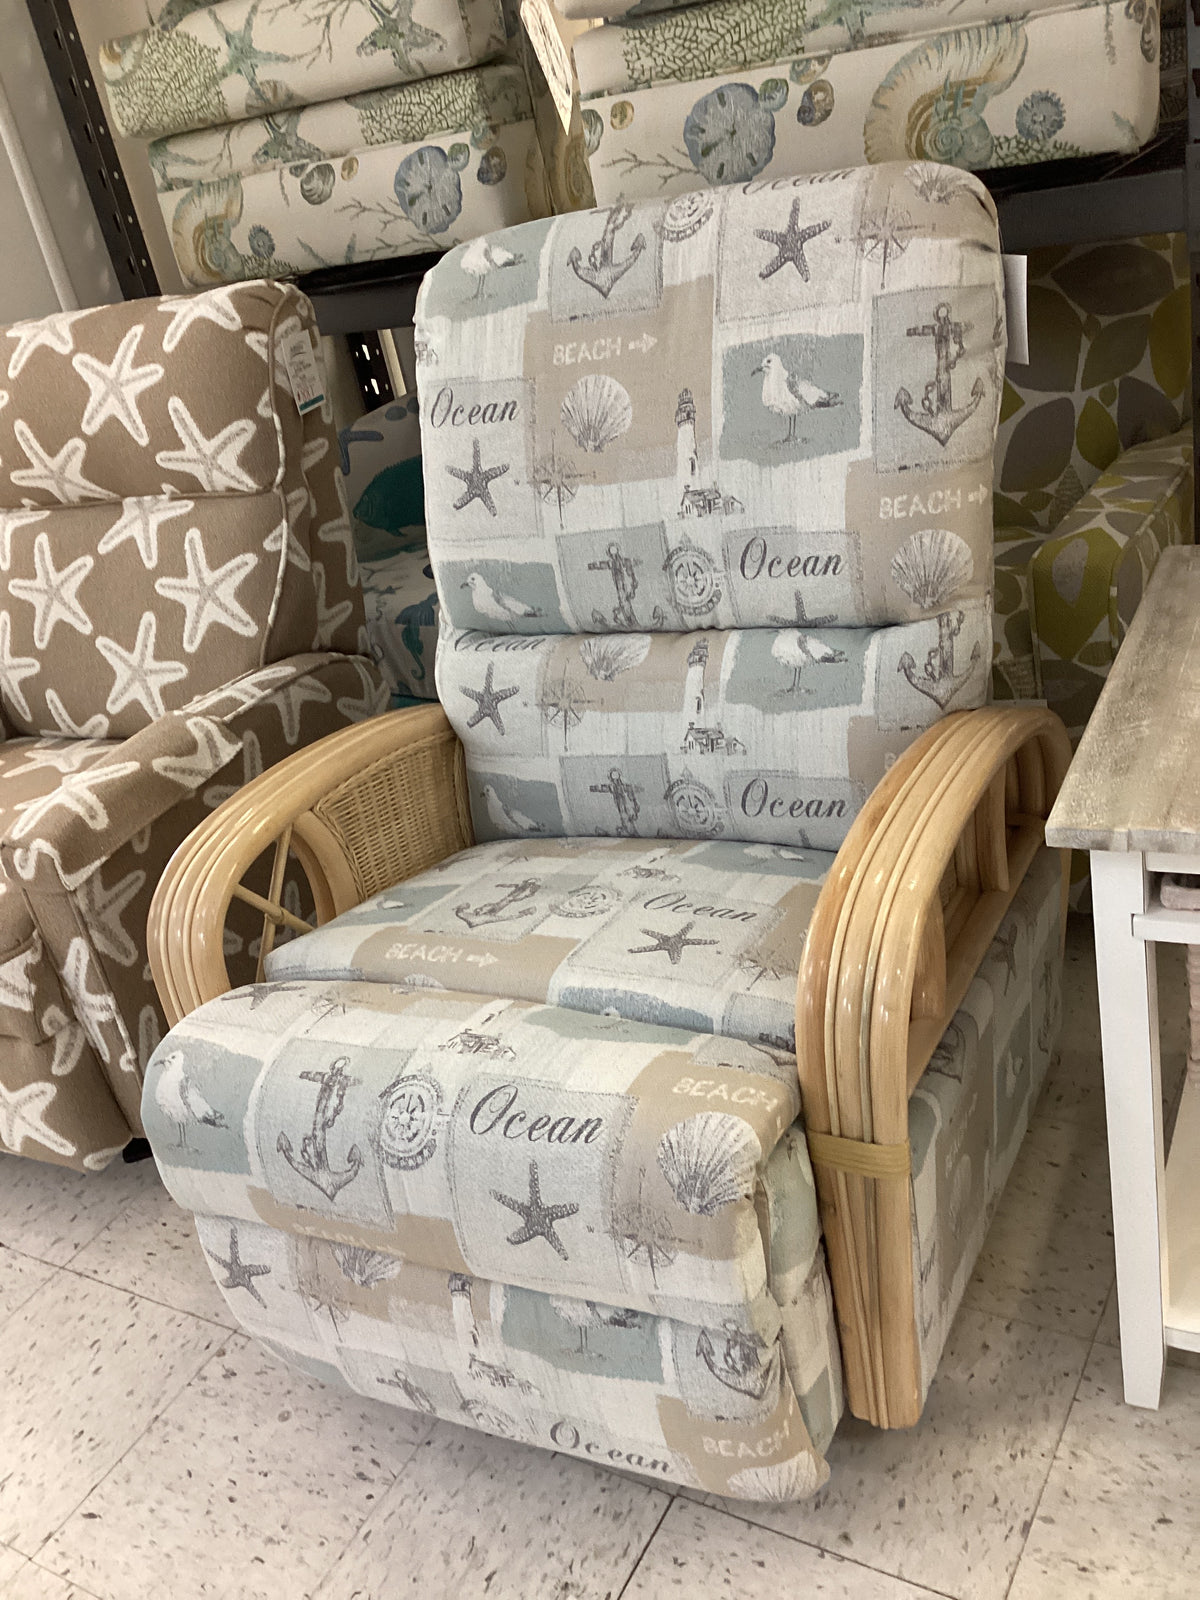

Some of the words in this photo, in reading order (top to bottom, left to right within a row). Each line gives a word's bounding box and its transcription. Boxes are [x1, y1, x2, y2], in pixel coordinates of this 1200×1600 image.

[553, 336, 622, 366] BEACH
[430, 387, 519, 428] Ocean
[879, 488, 961, 519] BEACH
[740, 536, 844, 580] Ocean
[741, 777, 847, 818] Ocean
[643, 891, 758, 922] Ocean
[385, 943, 464, 963] BEACH
[470, 1084, 603, 1144] Ocean
[672, 1077, 778, 1112] BEACH
[550, 1419, 673, 1474] Ocean
[702, 1419, 790, 1458] BEACH
